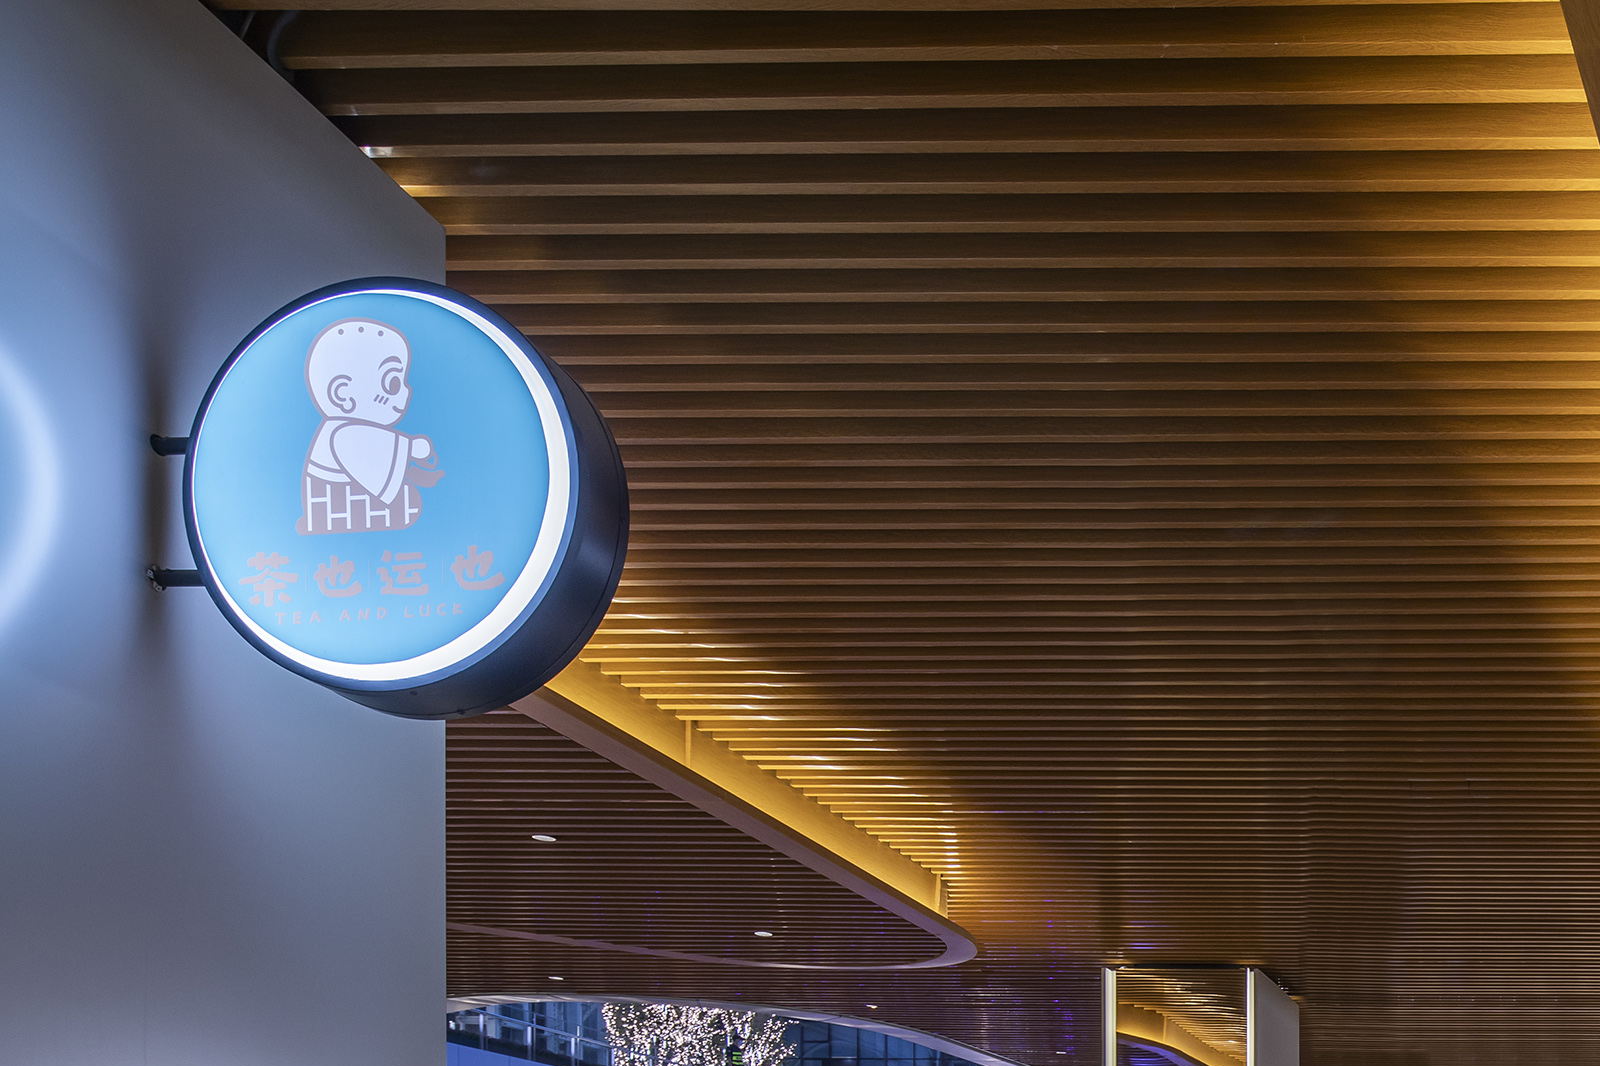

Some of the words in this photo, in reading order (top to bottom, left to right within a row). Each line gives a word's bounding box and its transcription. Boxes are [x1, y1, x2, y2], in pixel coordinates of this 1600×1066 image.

[239, 545, 505, 607] 茶也运也
[275, 611, 321, 625] TEA
[339, 606, 387, 622] AND
[404, 602, 463, 619] LUCK
